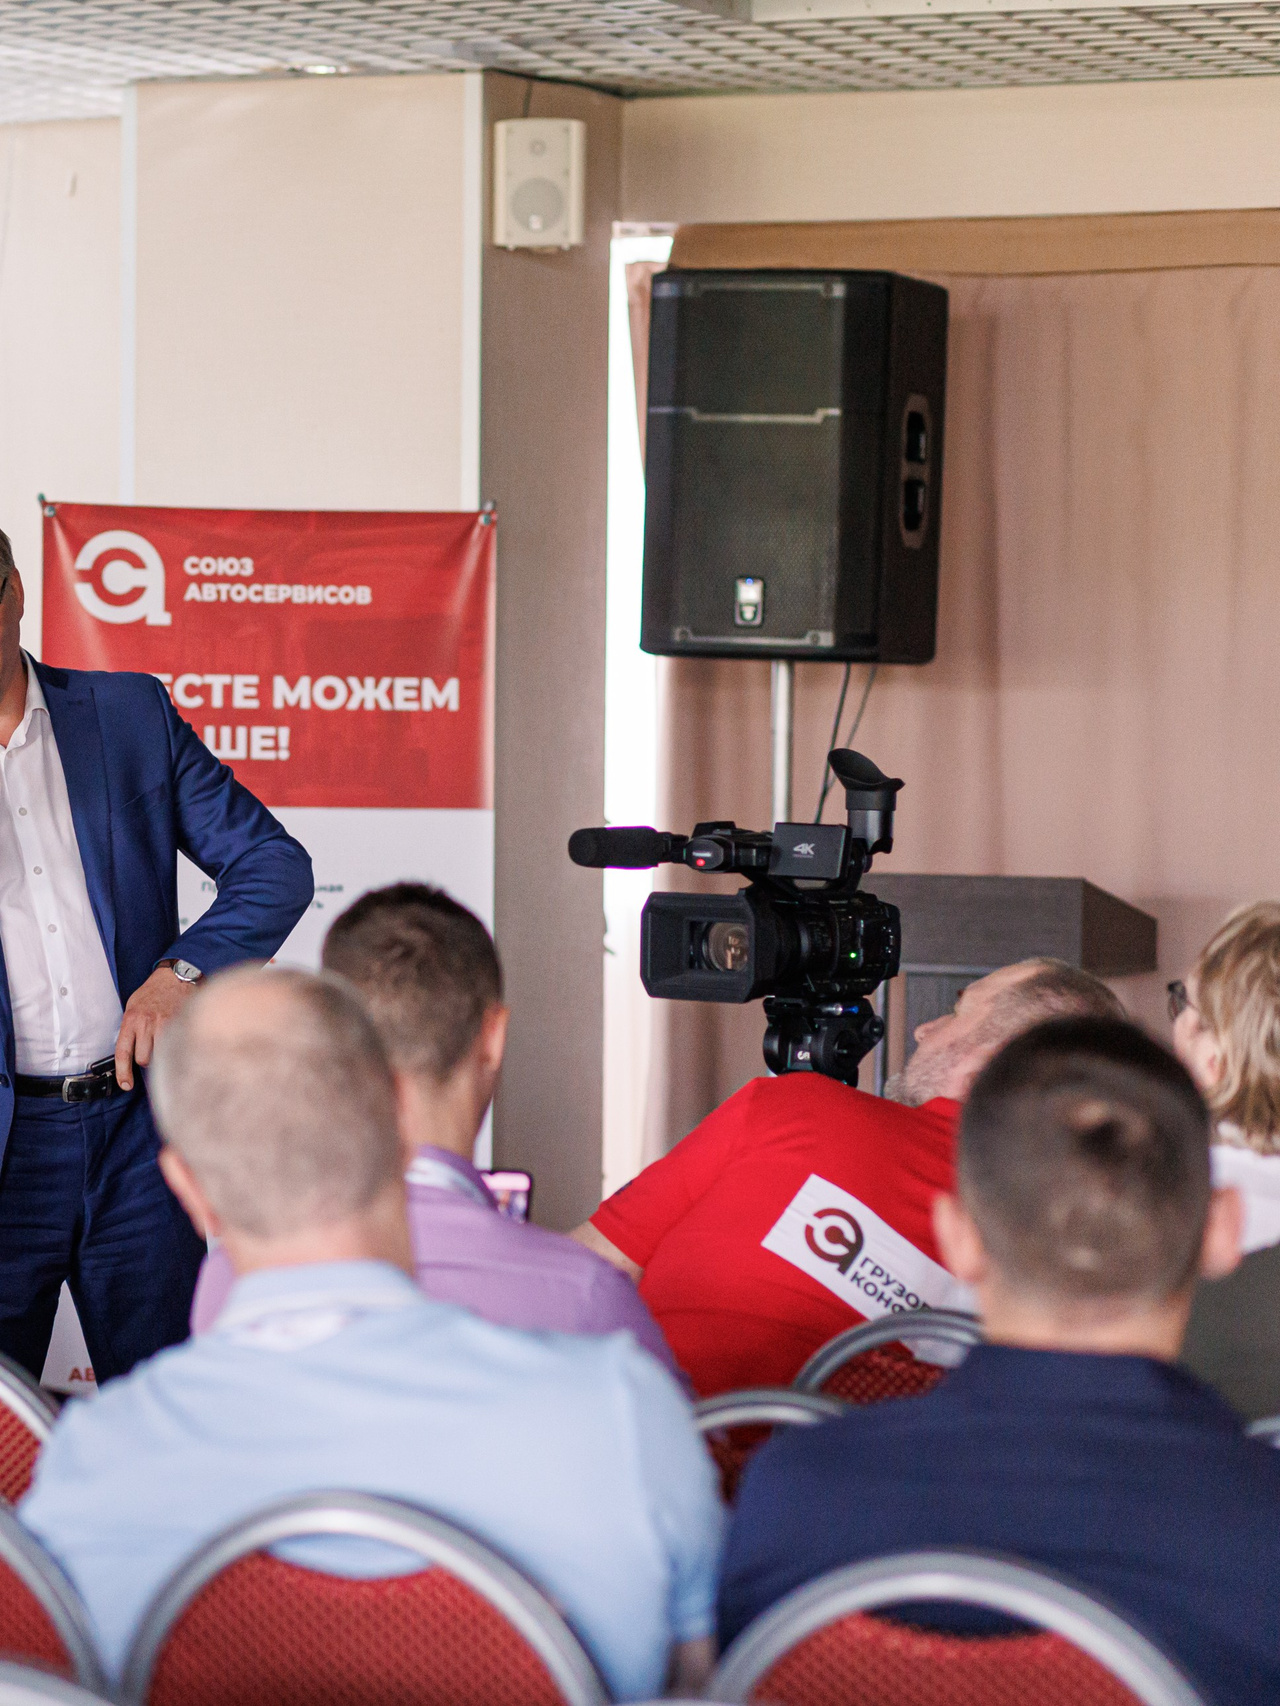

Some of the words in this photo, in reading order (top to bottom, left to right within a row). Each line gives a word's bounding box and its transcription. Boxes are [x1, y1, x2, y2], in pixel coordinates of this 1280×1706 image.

[184, 556, 254, 577] СОЮЗ
[184, 582, 372, 606] АВТОСЕРВИСОВ
[151, 673, 260, 710] СТЕ
[272, 675, 460, 712] МОЖЕМ
[792, 842, 816, 855] 4K
